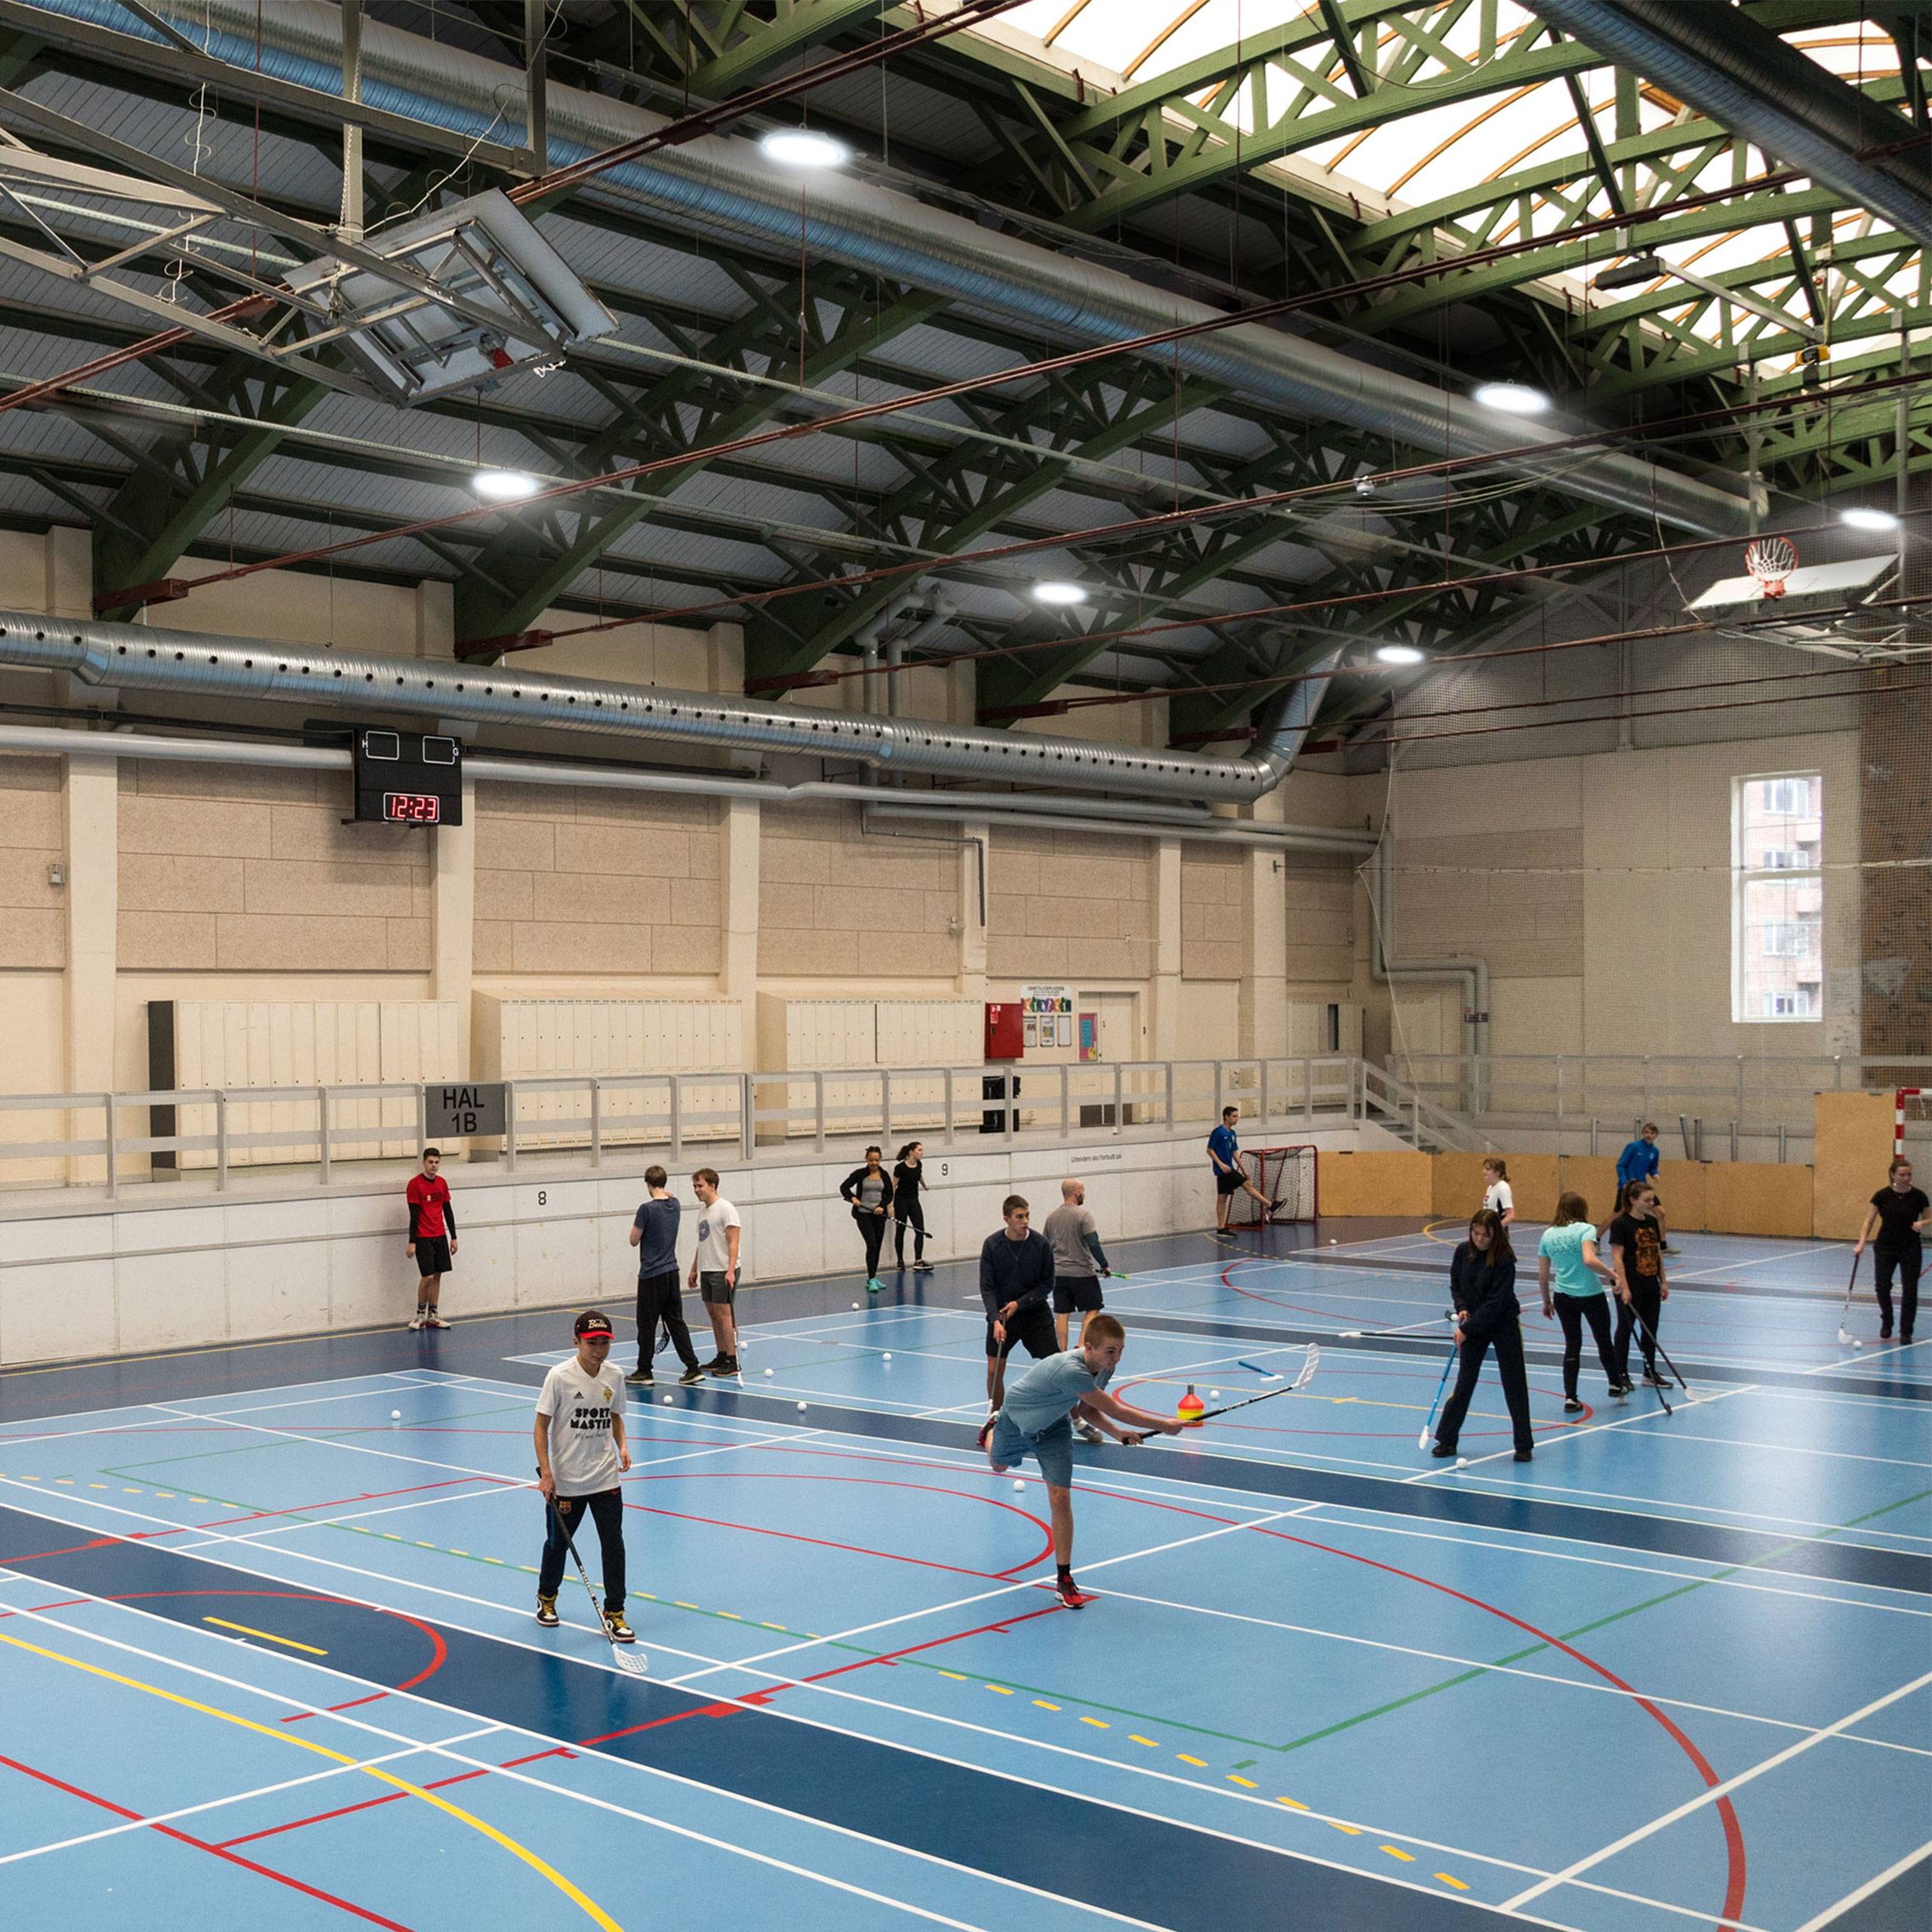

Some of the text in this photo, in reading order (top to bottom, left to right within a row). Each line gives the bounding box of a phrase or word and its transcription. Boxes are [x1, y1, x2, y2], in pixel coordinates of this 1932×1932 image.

[362, 740, 368, 748] H
[453, 747, 459, 756] G
[392, 797, 436, 819] 12:23
[443, 1088, 485, 1109] HAL
[451, 1112, 477, 1134] 1B
[942, 1163, 948, 1176] 9
[538, 1191, 546, 1205] 8
[574, 1407, 611, 1418] SPORT
